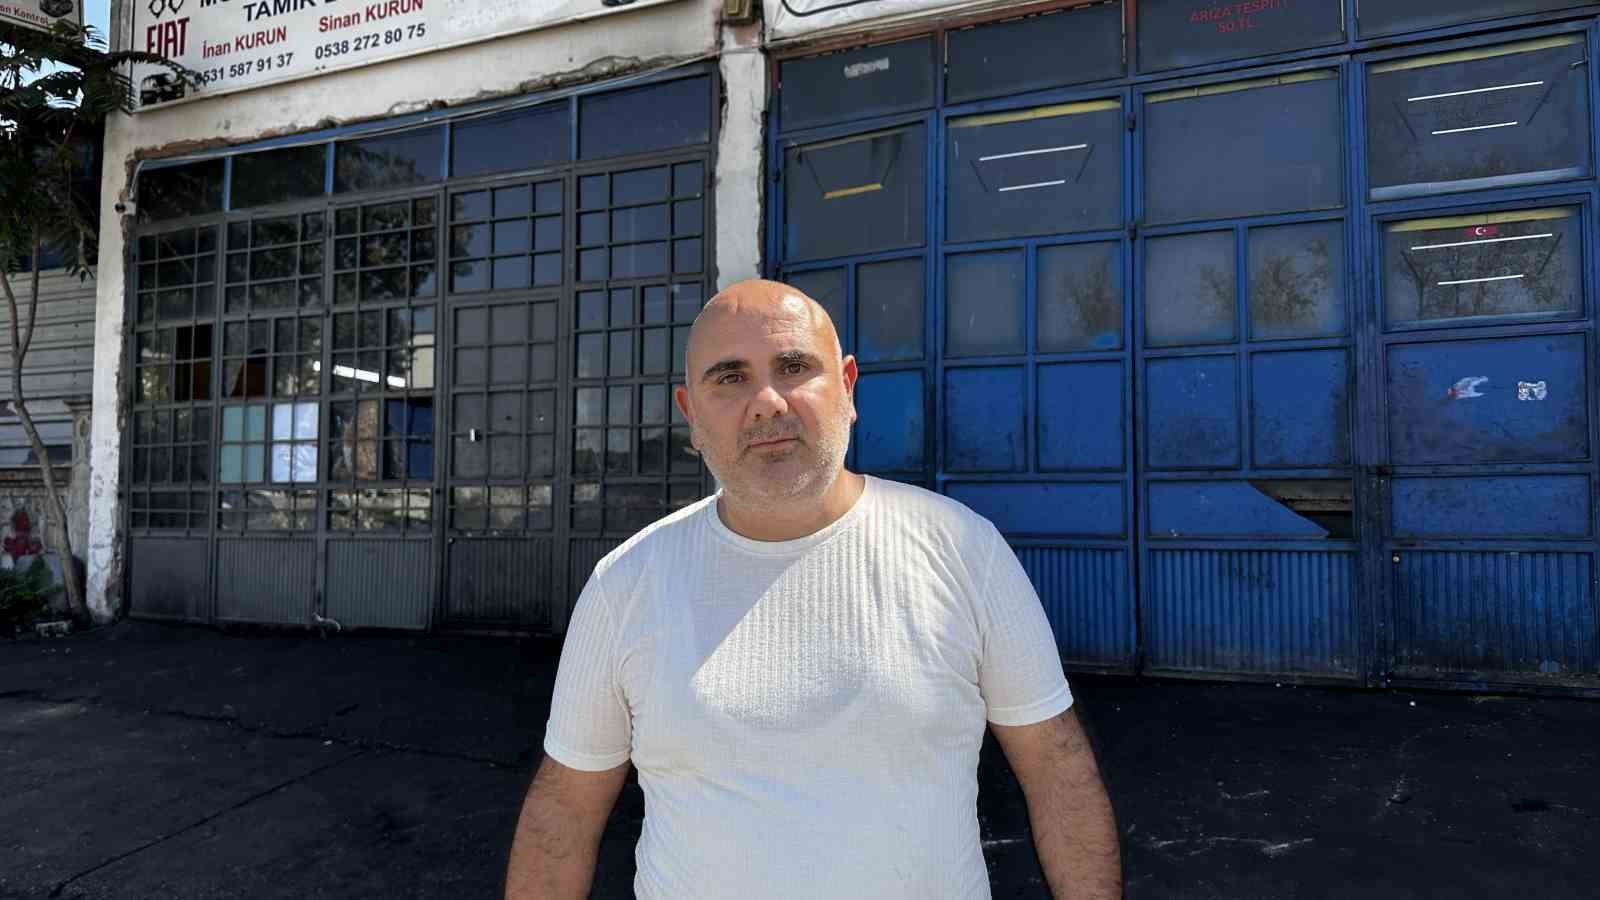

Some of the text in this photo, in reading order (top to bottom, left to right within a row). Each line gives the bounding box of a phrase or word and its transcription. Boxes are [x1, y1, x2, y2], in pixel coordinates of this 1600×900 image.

[319, 0, 424, 33] Sinan KURUN
[147, 17, 190, 59] FIAT
[235, 26, 287, 52] KURUN
[315, 23, 426, 60] 0538 272 80 75
[230, 61, 252, 78] 587
[257, 57, 272, 72] 91
[277, 53, 294, 68] 37
